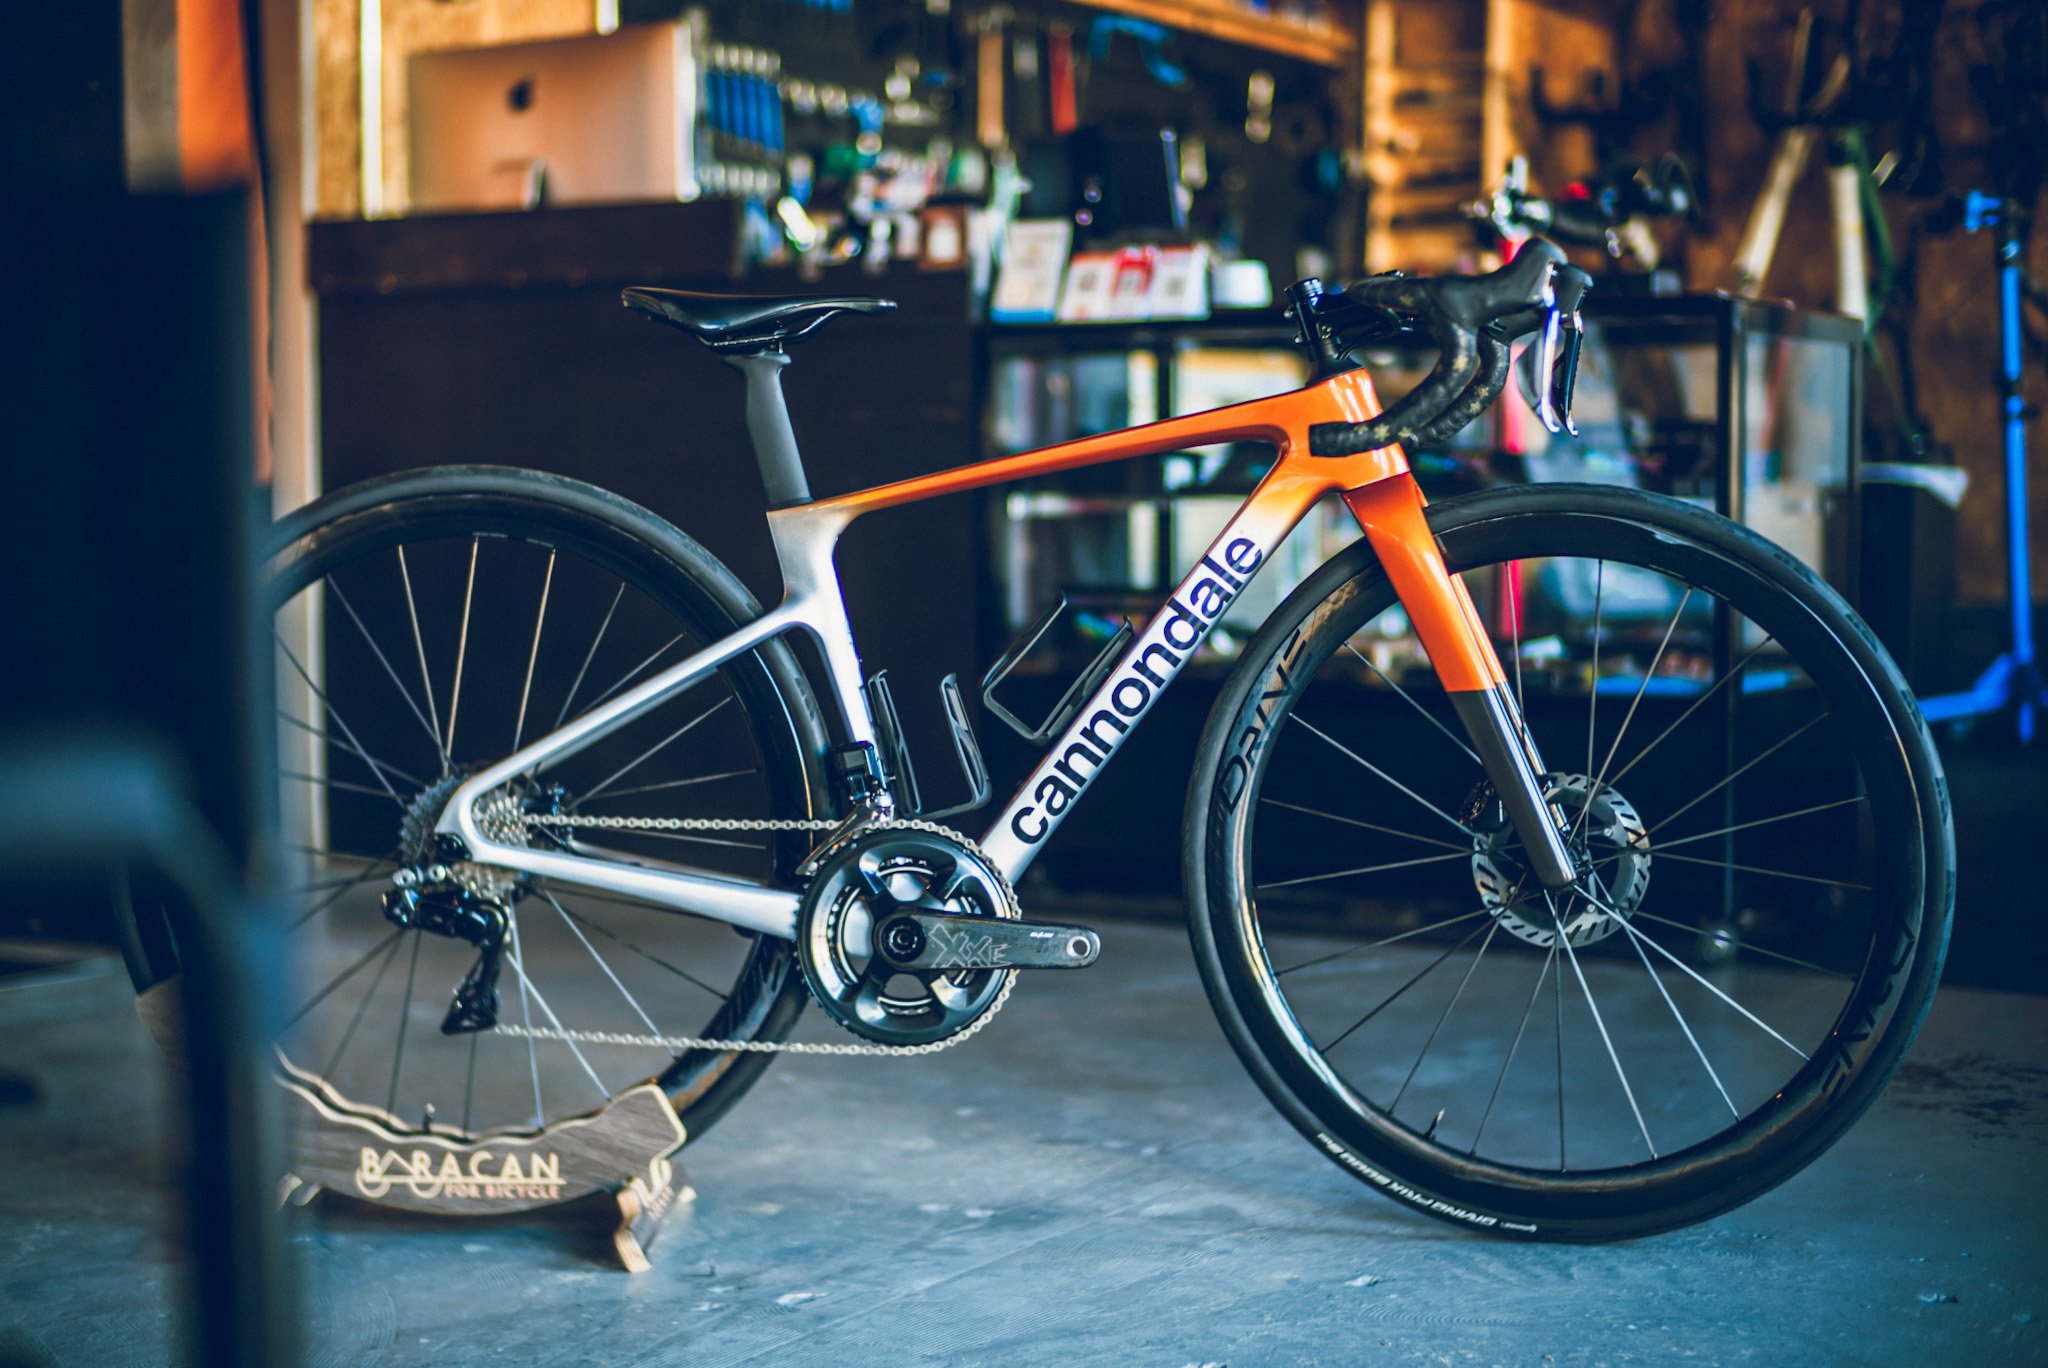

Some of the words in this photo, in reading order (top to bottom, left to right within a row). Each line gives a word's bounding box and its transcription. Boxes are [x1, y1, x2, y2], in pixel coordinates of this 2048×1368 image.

[1011, 537, 1262, 845] cannondale
[1216, 628, 1313, 815] DRIVE
[359, 1146, 561, 1182] BARACAN
[444, 1184, 480, 1199] FOR
[485, 1184, 561, 1199] BICYCLE
